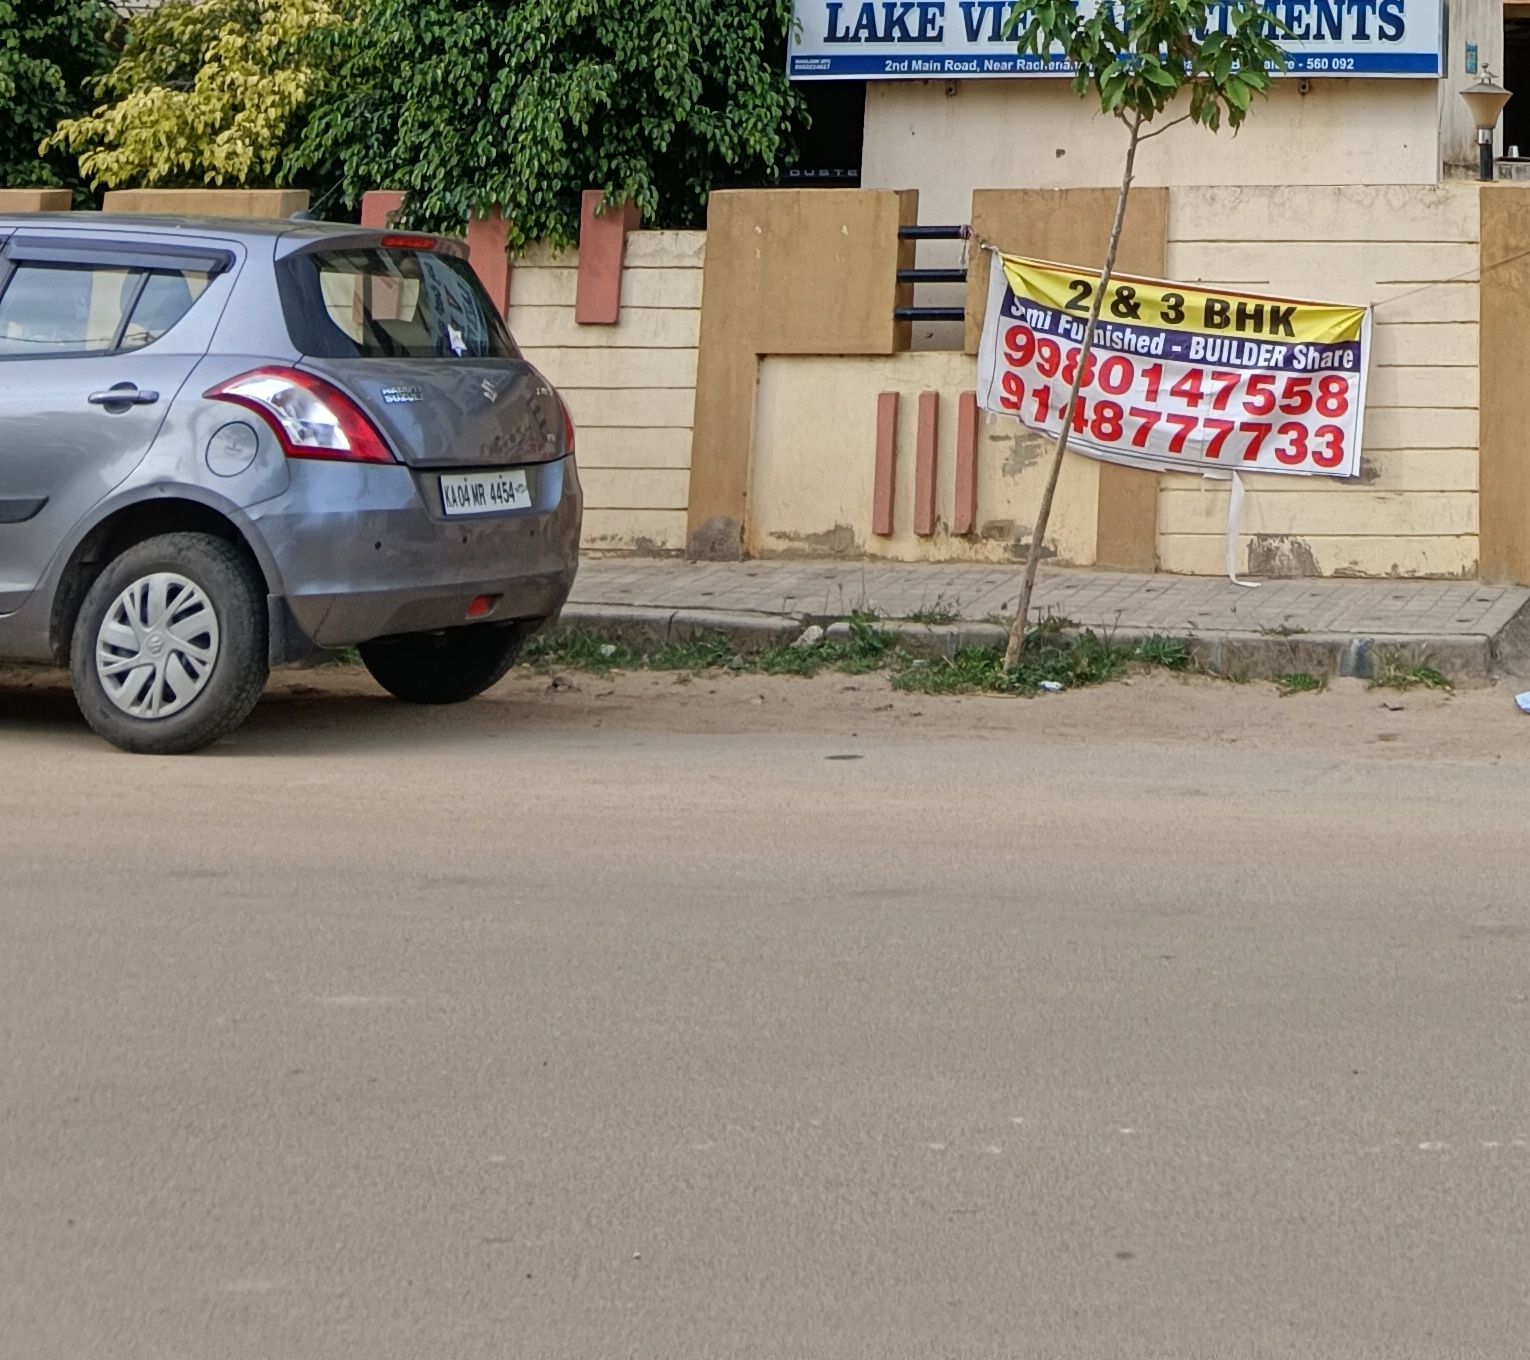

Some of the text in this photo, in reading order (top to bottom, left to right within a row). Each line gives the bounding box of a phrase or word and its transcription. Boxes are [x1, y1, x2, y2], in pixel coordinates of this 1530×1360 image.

[824, 1, 944, 44] LAKE
[885, 60, 908, 72] 2nd
[911, 60, 941, 72] Main
[945, 59, 980, 73] Road,
[984, 59, 1013, 71] Near
[1306, 58, 1330, 71] 560
[1332, 58, 1355, 71] 092
[1064, 279, 1298, 338] 2 & 3 BHK
[1058, 316, 1166, 357] Funished
[1189, 336, 1285, 368] BUILDER
[1293, 344, 1354, 370] Share
[1004, 324, 1350, 418] 9980147558
[1000, 371, 1345, 468] 9148777733
[490, 481, 515, 505] 4454
